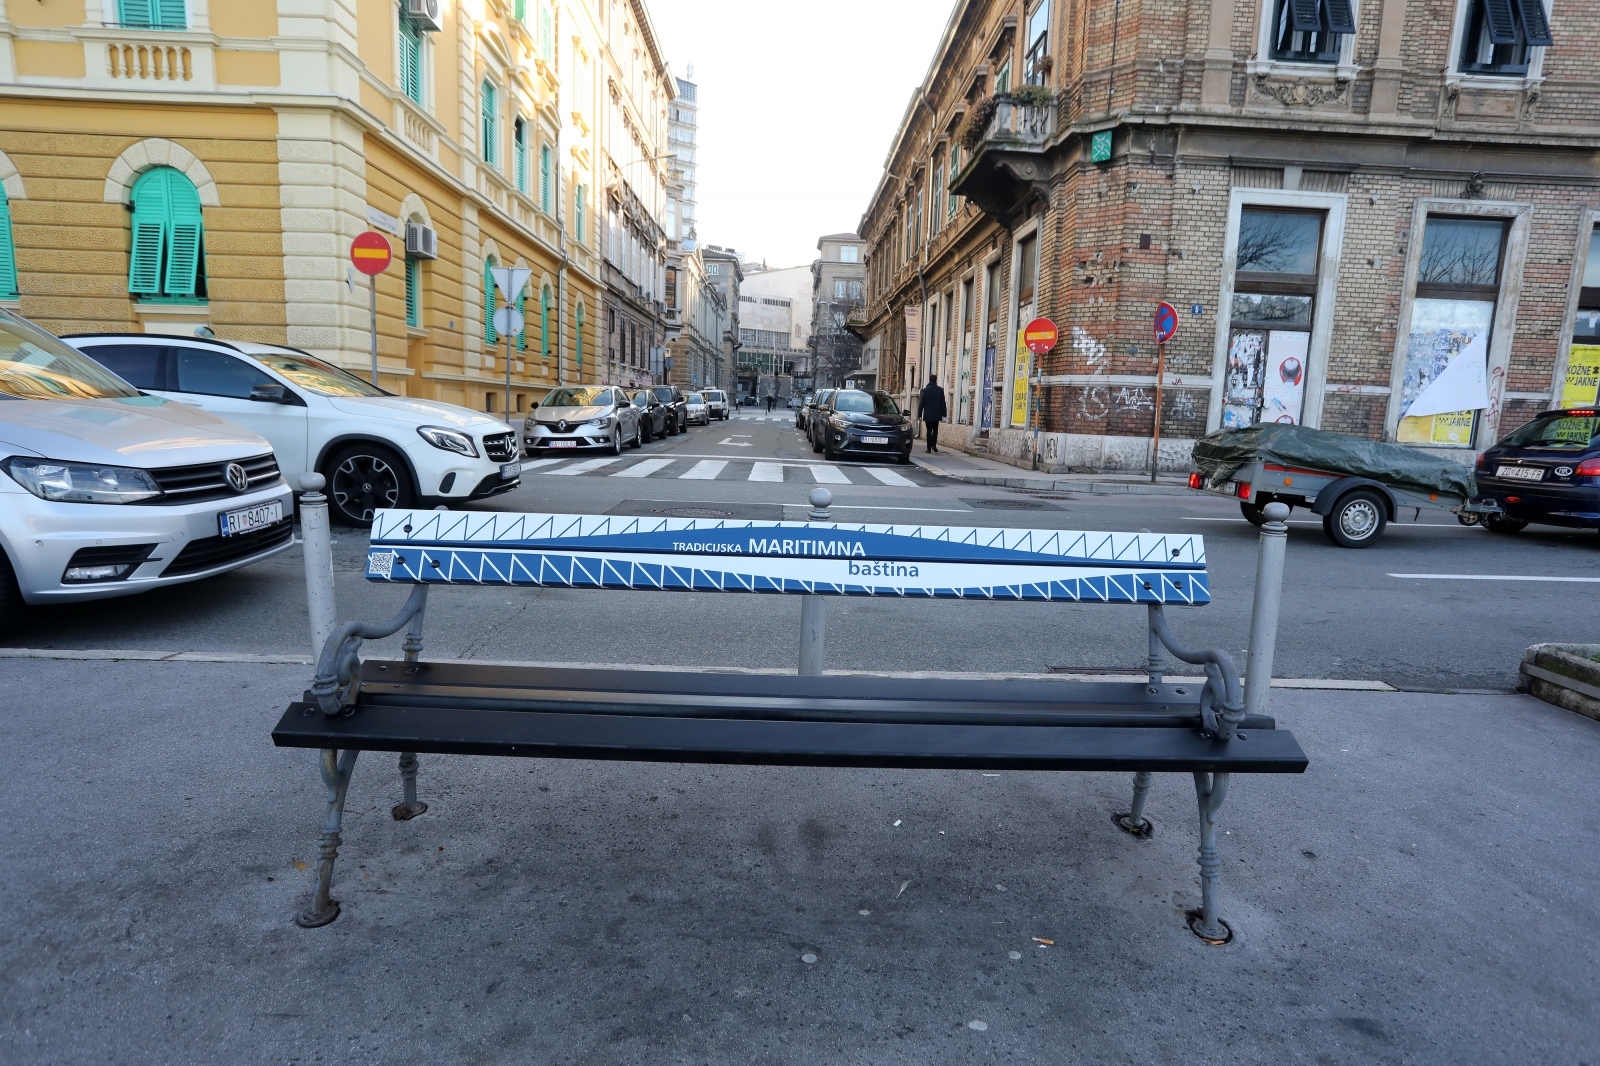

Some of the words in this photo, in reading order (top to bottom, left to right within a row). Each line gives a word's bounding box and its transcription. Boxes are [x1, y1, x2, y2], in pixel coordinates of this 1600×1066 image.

[1566, 363, 1592, 375] KOŽNE
[1573, 377, 1598, 387] JAKNE
[1448, 417, 1472, 427] JAKNE
[672, 542, 742, 553] TRADICIJSKA
[749, 538, 866, 557] MARITIMNA
[848, 560, 919, 577] baština
